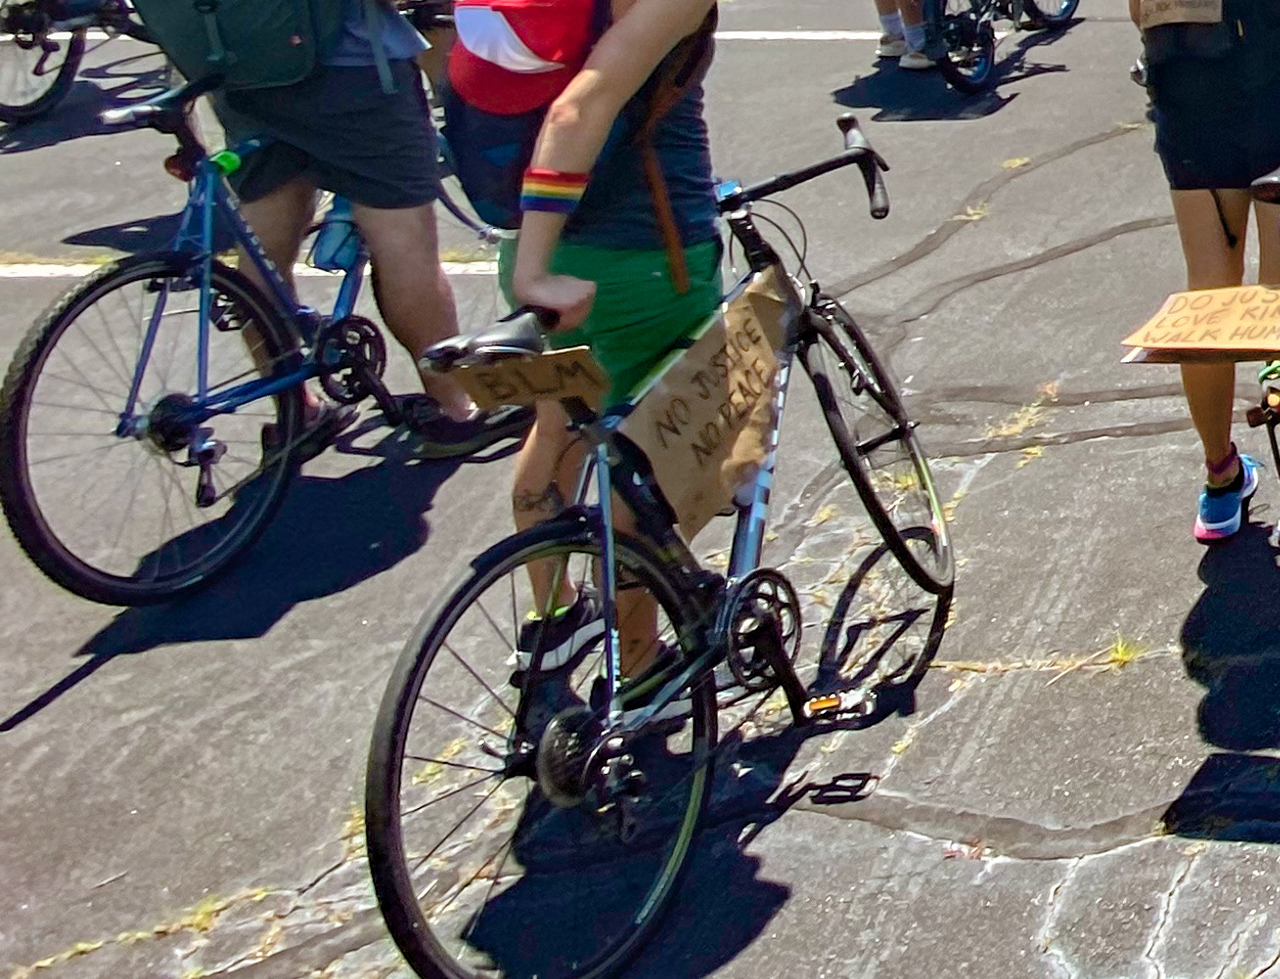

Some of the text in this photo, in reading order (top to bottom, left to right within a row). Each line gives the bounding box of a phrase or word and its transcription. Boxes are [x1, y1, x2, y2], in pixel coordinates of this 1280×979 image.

[1154, 308, 1232, 330] LOVE
[1167, 294, 1214, 315] DO
[1142, 327, 1221, 345] WALK
[475, 360, 605, 401] BLM
[655, 317, 762, 450] NO JUSTICE
[689, 356, 769, 466] NO PEACE
